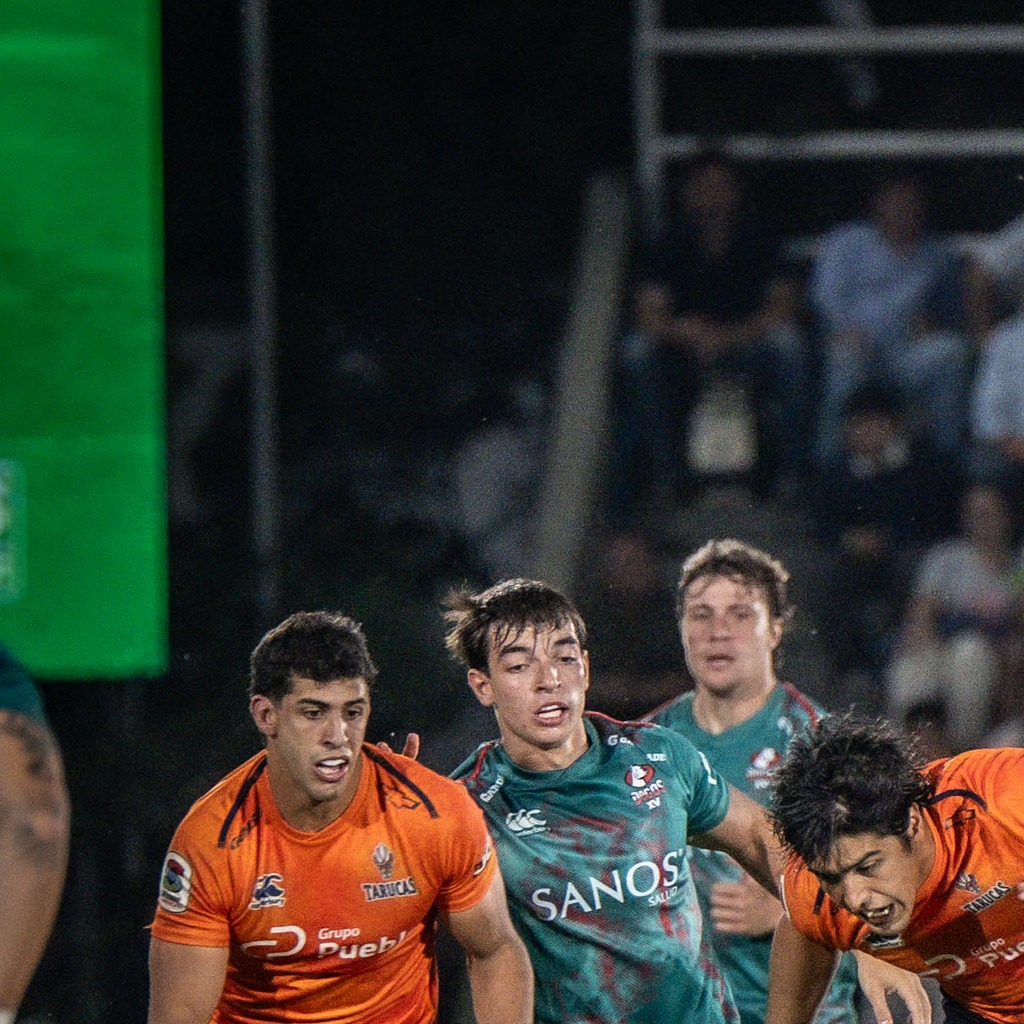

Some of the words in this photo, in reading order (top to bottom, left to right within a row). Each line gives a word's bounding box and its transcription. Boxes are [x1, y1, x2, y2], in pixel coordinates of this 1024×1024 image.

[363, 877, 418, 901] TARUCAS
[531, 851, 679, 922] SANOS
[962, 881, 1012, 915] TARUCAS
[318, 927, 361, 941] Grupo
[970, 938, 1005, 955] Grupo
